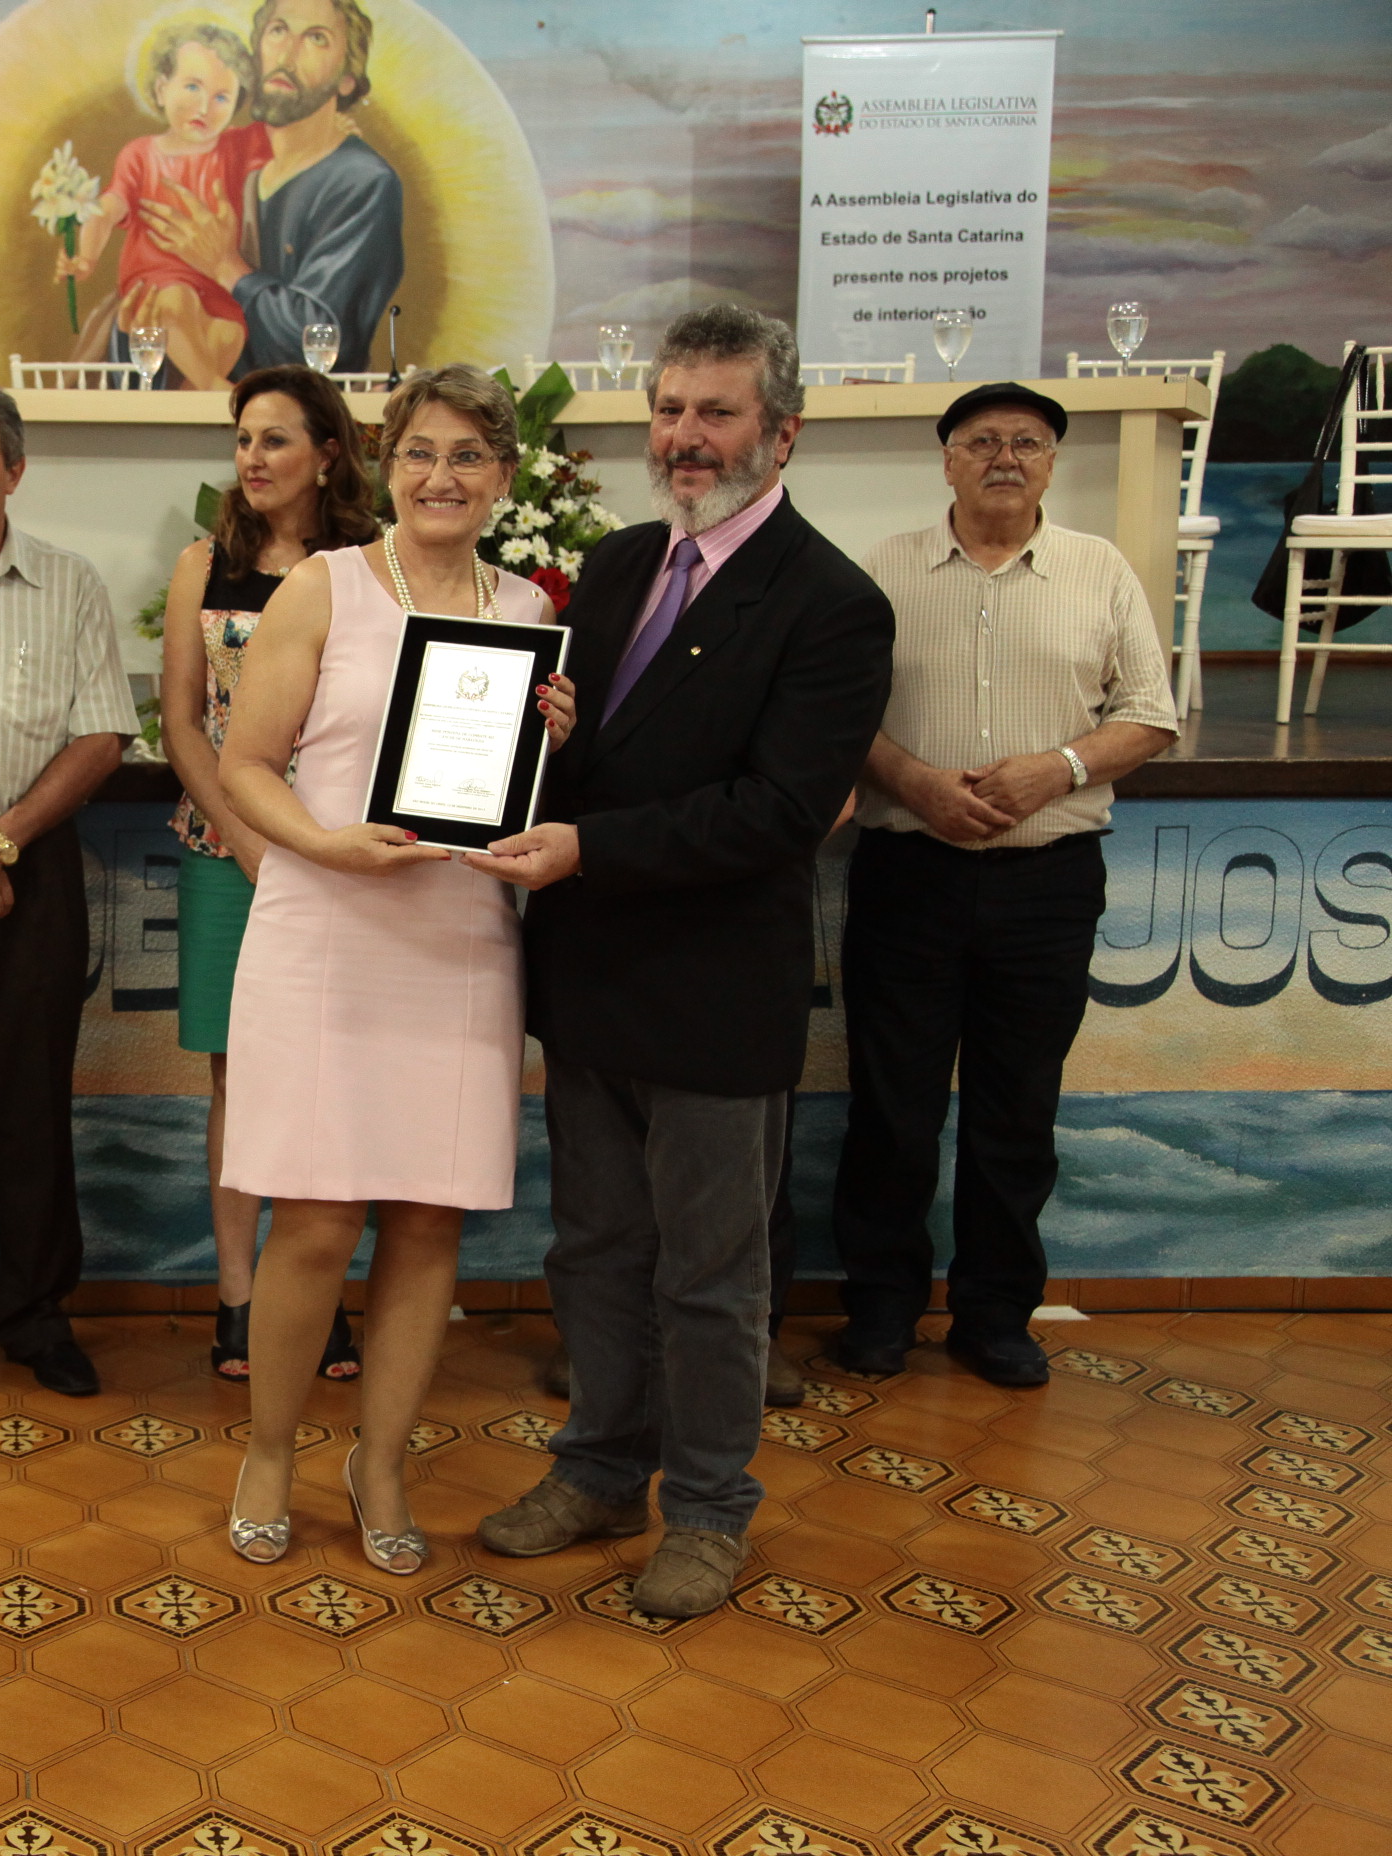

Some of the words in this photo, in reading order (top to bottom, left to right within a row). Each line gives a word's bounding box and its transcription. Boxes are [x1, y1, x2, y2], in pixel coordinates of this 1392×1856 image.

[861, 98, 946, 113] ASSEMBLEIA
[951, 96, 1038, 111] LEGISLATIVA
[859, 119, 878, 130] DO
[880, 118, 924, 129] ESTADO
[927, 117, 943, 128] DE
[945, 116, 980, 128] SANTA
[982, 115, 1037, 127] CATARINA
[810, 193, 823, 207] A
[825, 191, 921, 208] Assembleia
[925, 189, 1013, 209] Legislativa
[1016, 189, 1038, 204] do
[820, 231, 878, 247] Estado
[882, 230, 903, 245] de
[906, 229, 953, 245] Santa
[957, 228, 1025, 244] Catarina
[832, 269, 905, 288] presente
[908, 270, 939, 283] nos
[942, 267, 1009, 285] projetos
[852, 308, 874, 323] de
